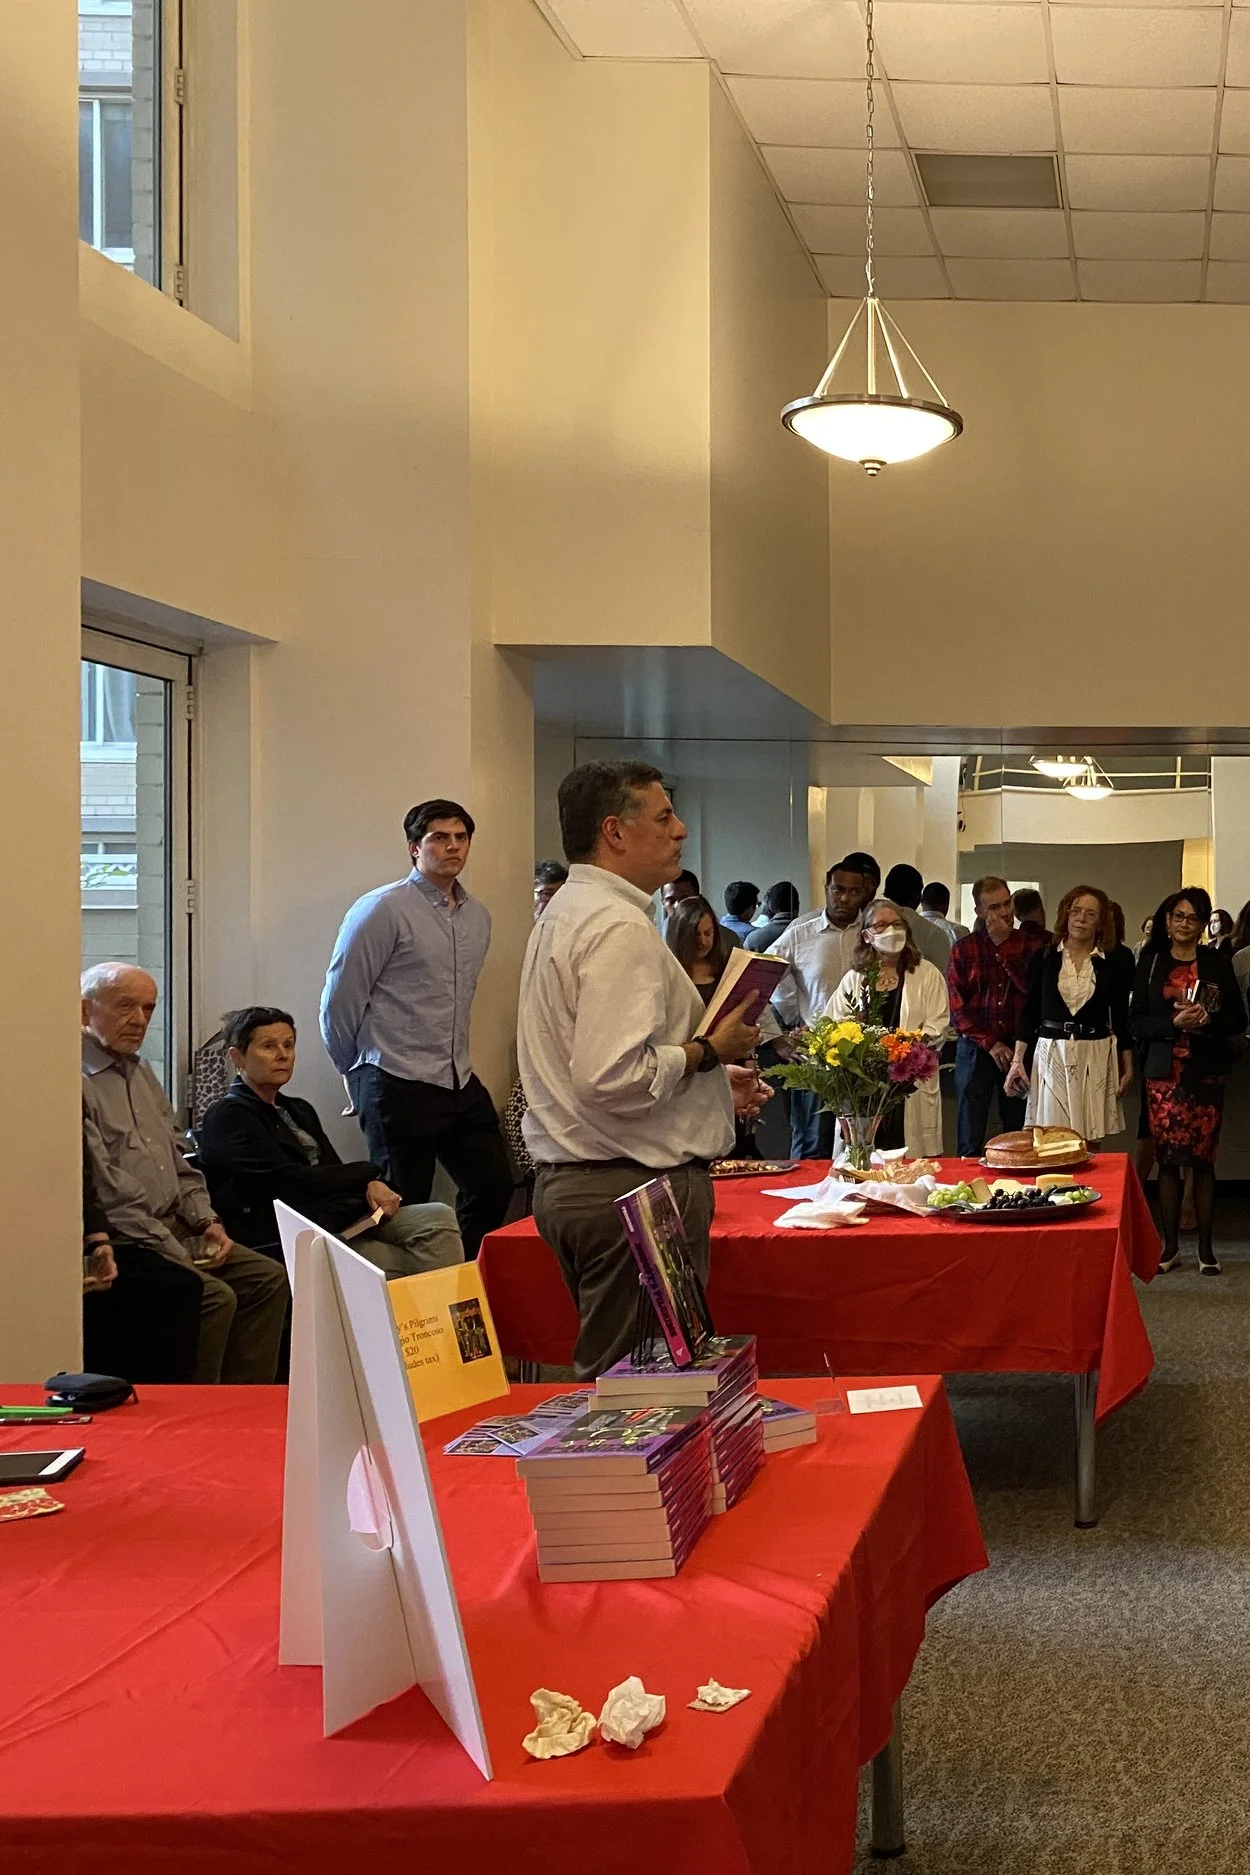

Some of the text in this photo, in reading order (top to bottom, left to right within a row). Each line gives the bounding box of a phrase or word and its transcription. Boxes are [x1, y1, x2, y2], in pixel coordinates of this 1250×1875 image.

[409, 1316, 439, 1328] Pilgrims
[410, 1328, 444, 1341] Troncoso
[405, 1346, 419, 1357] $20
[425, 1353, 440, 1364] tax)
